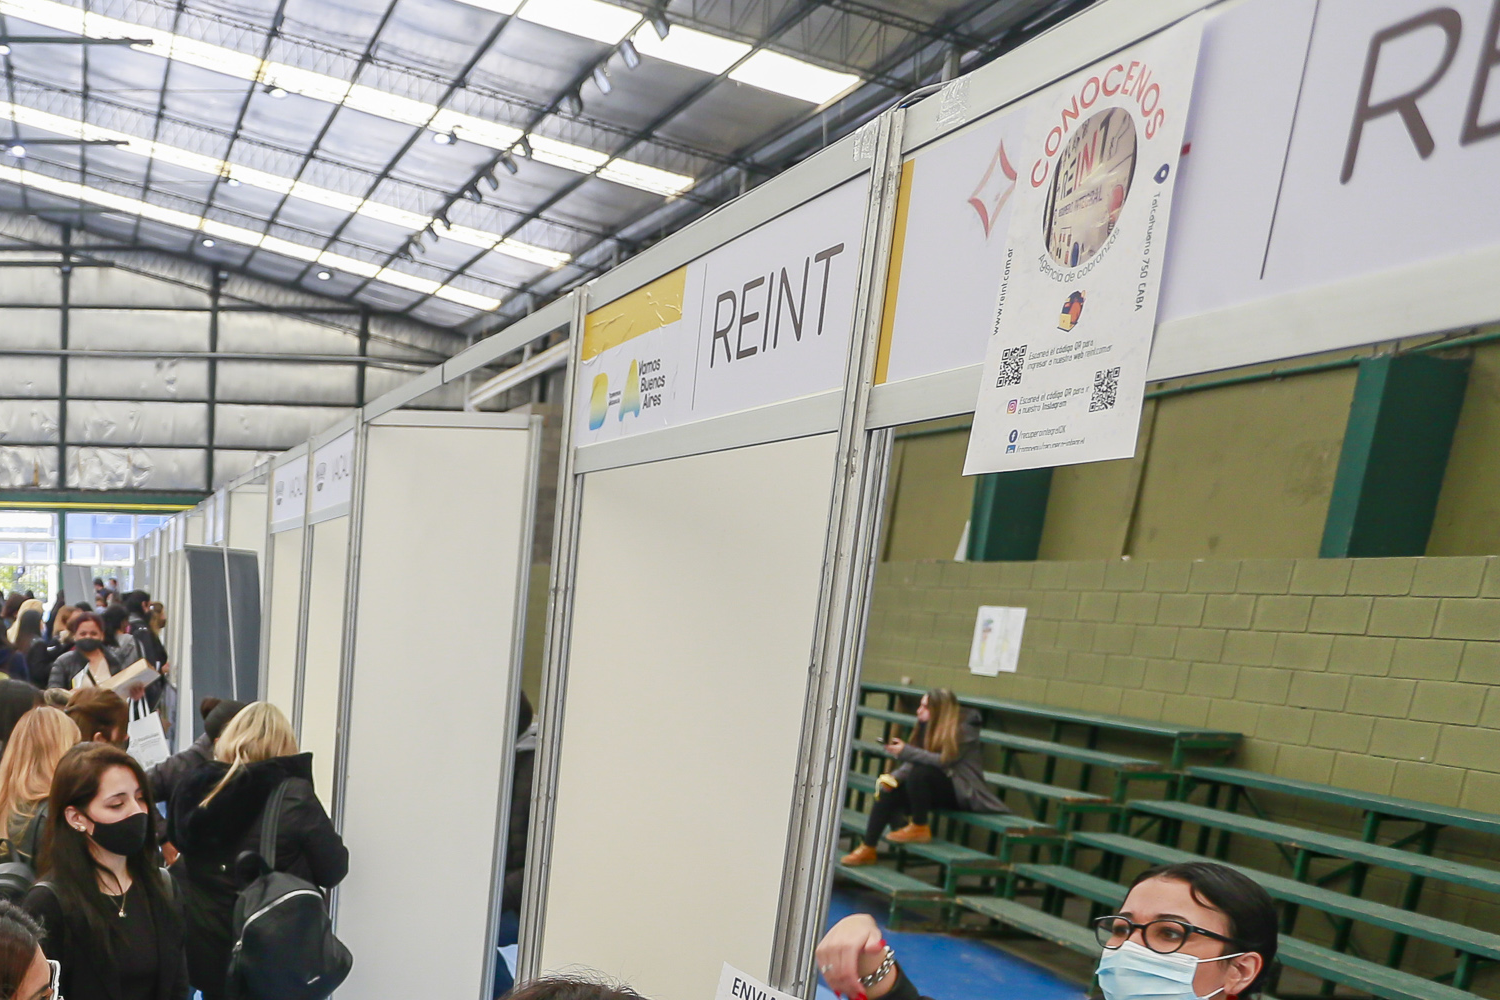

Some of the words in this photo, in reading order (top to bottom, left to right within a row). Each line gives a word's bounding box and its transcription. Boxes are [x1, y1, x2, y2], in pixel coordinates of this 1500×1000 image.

[1030, 61, 1165, 188] CONOCENOS
[1143, 191, 1161, 256] Talcahuano
[1037, 253, 1064, 283] Agencia
[1064, 266, 1076, 283] de
[1076, 227, 1120, 281] cobranzas
[1140, 258, 1151, 279] 750
[710, 242, 845, 369] REINT
[992, 247, 1014, 336] www.reint.com.ar
[1134, 282, 1147, 312] CABA
[638, 358, 661, 377] Vamos
[1073, 351, 1084, 360] web
[640, 375, 666, 393] Buenos
[642, 393, 662, 410] Aires
